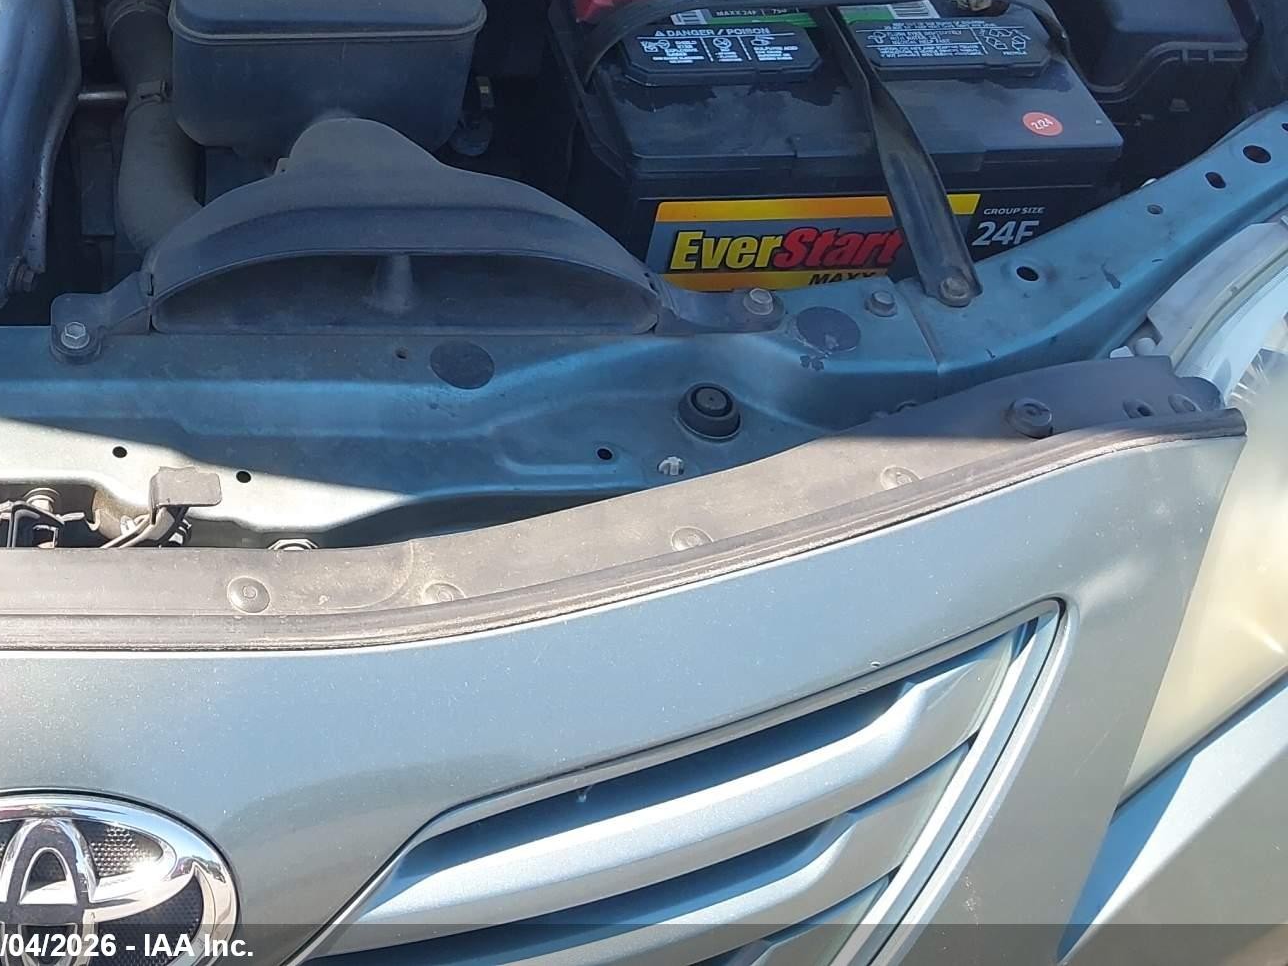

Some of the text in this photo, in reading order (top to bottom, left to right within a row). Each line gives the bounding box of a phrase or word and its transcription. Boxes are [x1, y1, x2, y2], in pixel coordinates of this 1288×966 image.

[665, 29, 715, 37] DANGER
[727, 27, 771, 35] POISON
[983, 206, 1046, 215] GROUP SIZE
[971, 220, 1040, 246] 24F
[668, 227, 907, 273] EverStart
